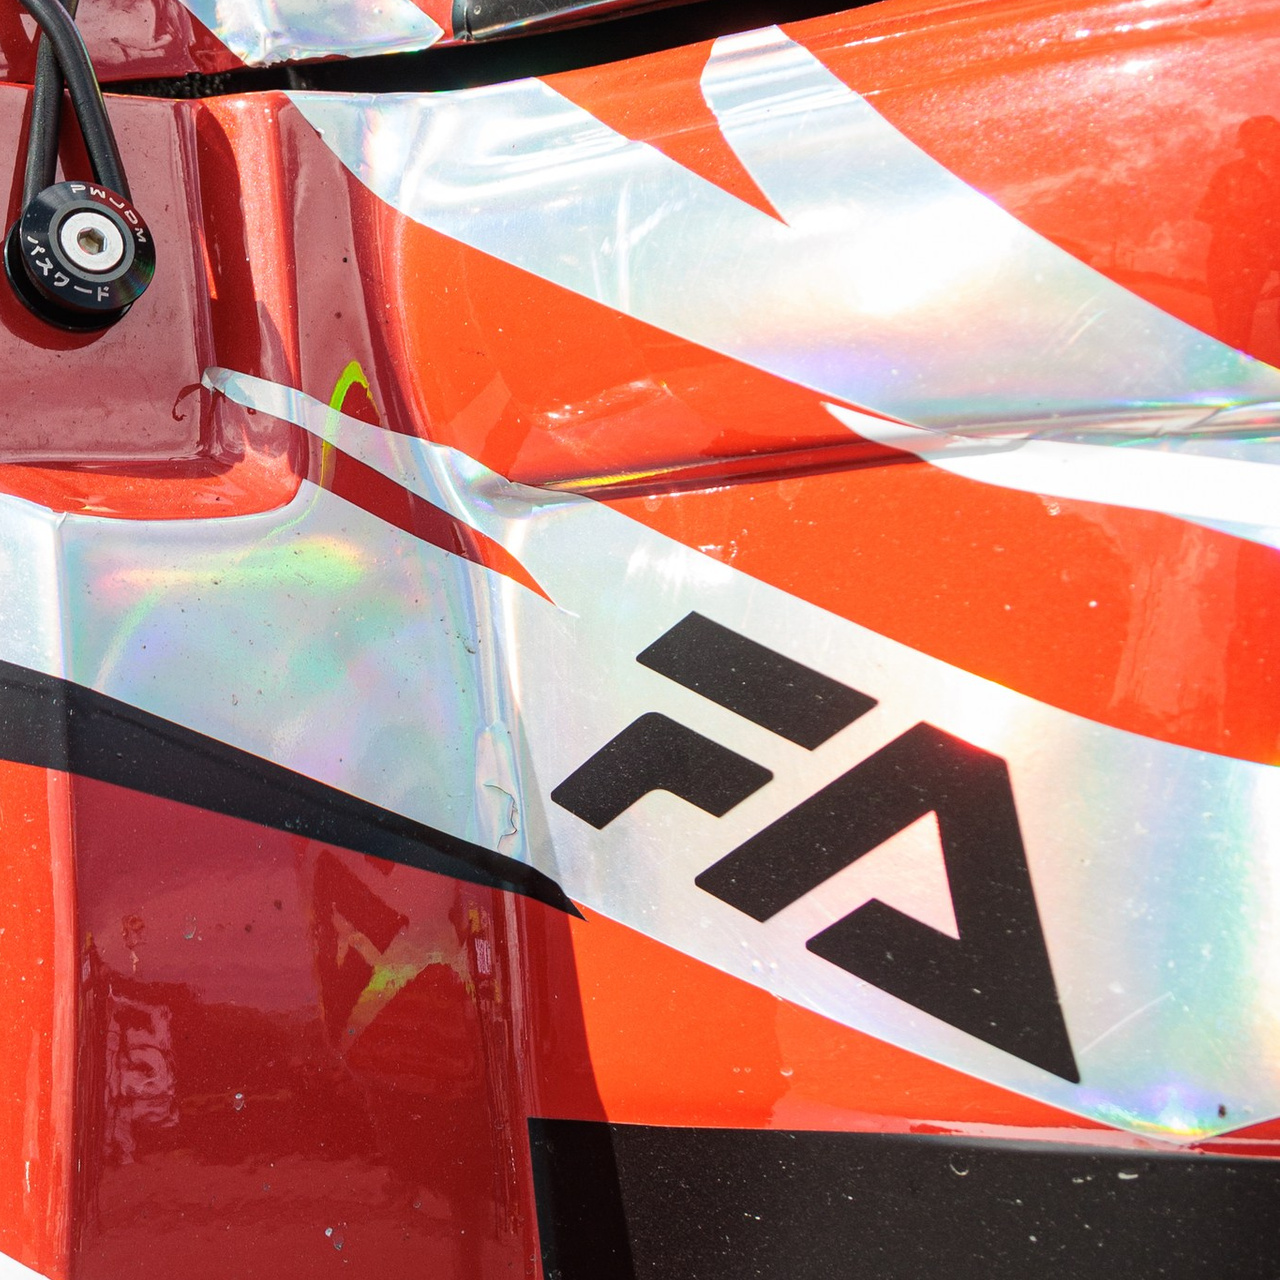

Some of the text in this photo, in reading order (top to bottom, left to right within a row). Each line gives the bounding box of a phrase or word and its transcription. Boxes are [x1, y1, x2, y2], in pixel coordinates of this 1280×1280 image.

[70, 183, 147, 243] PWJDM
[27, 235, 110, 302] パスワード
[550, 610, 1081, 1084] FA
